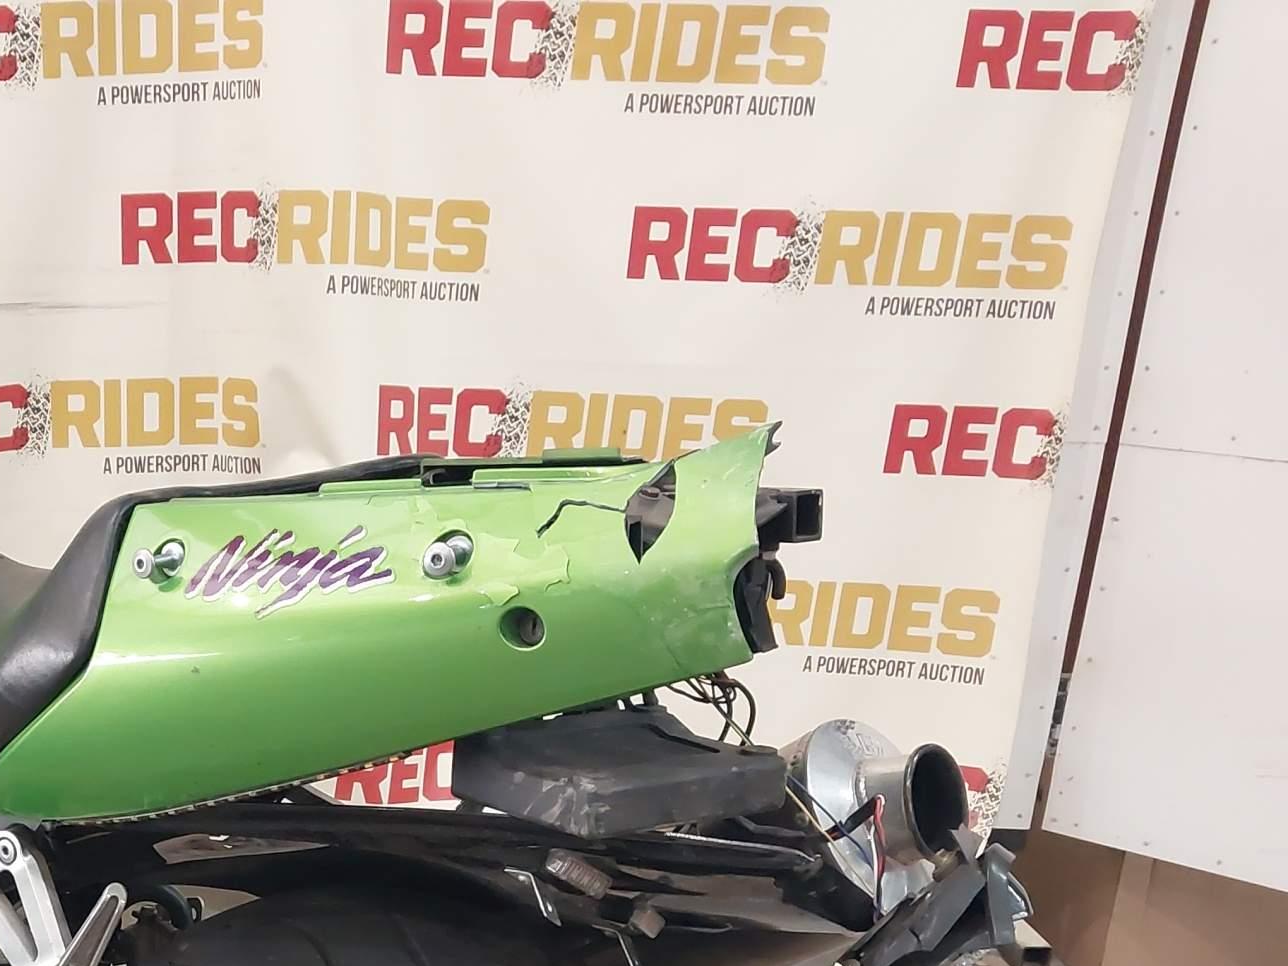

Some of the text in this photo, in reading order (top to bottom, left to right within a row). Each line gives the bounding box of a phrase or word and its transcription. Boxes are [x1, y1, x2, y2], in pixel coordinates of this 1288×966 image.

[40, 0, 265, 79] RIDES
[571, 0, 831, 85] RIDES
[97, 80, 261, 105] A POWERSPORT AUCTION
[624, 93, 816, 116] A POWERSPORT AUCTION
[276, 190, 491, 273] RIDES
[814, 210, 1073, 290] RIDES
[327, 275, 480, 302] A POWERSPORT AUCTION
[865, 296, 1055, 320] A POWERSPORT AUCTION
[50, 377, 261, 448] RIDES
[103, 454, 261, 474] A POWERSPORT AUCTION
[185, 524, 397, 620] Ninja
[802, 656, 985, 685] A POWERSPORT AUCTION
